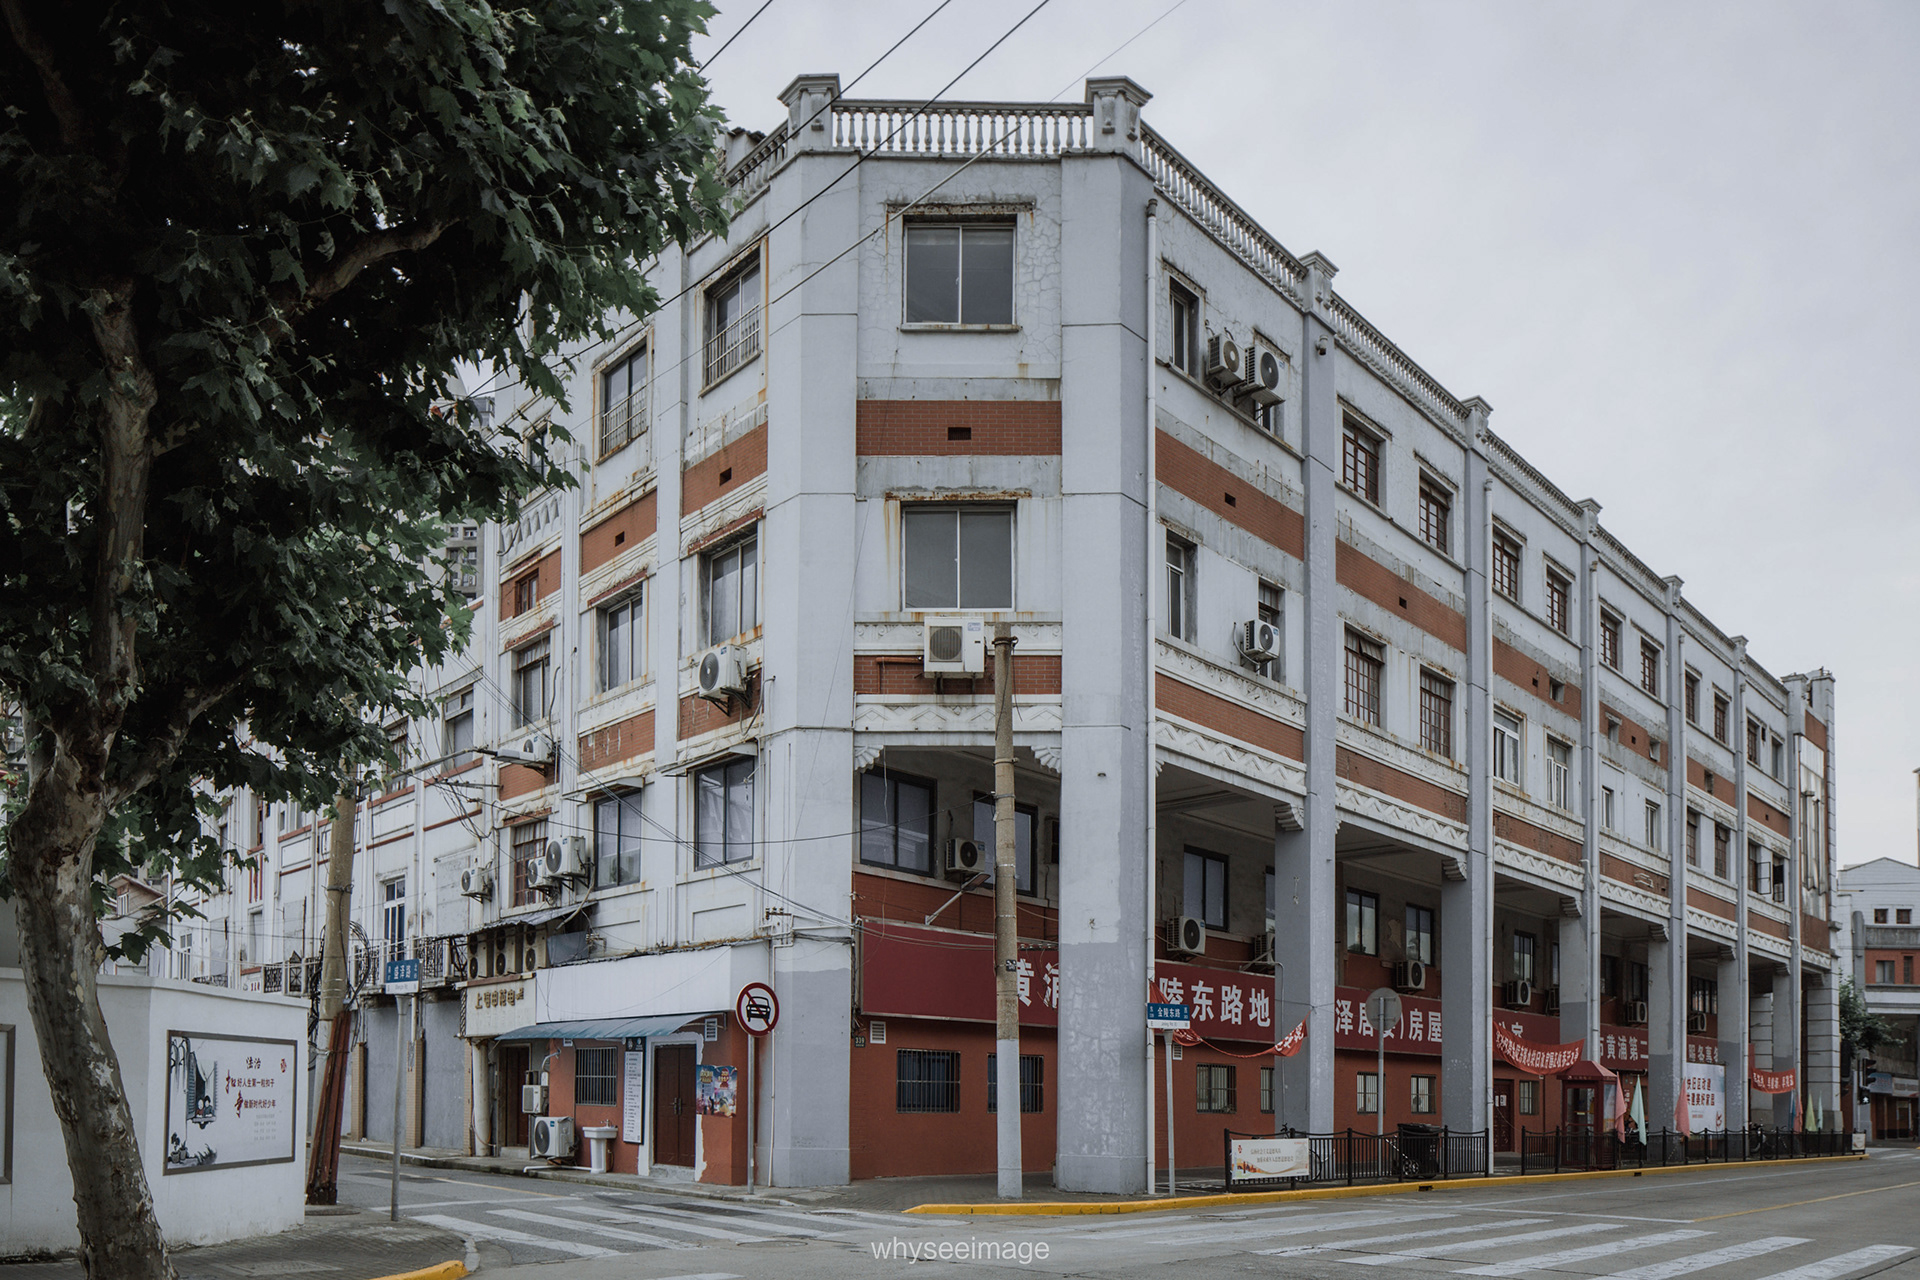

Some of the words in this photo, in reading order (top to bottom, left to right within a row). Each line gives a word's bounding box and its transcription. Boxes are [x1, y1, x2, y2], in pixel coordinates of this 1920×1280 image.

[1157, 1006, 1181, 1019] 金陵东路
[246, 1056, 261, 1070] 法治
